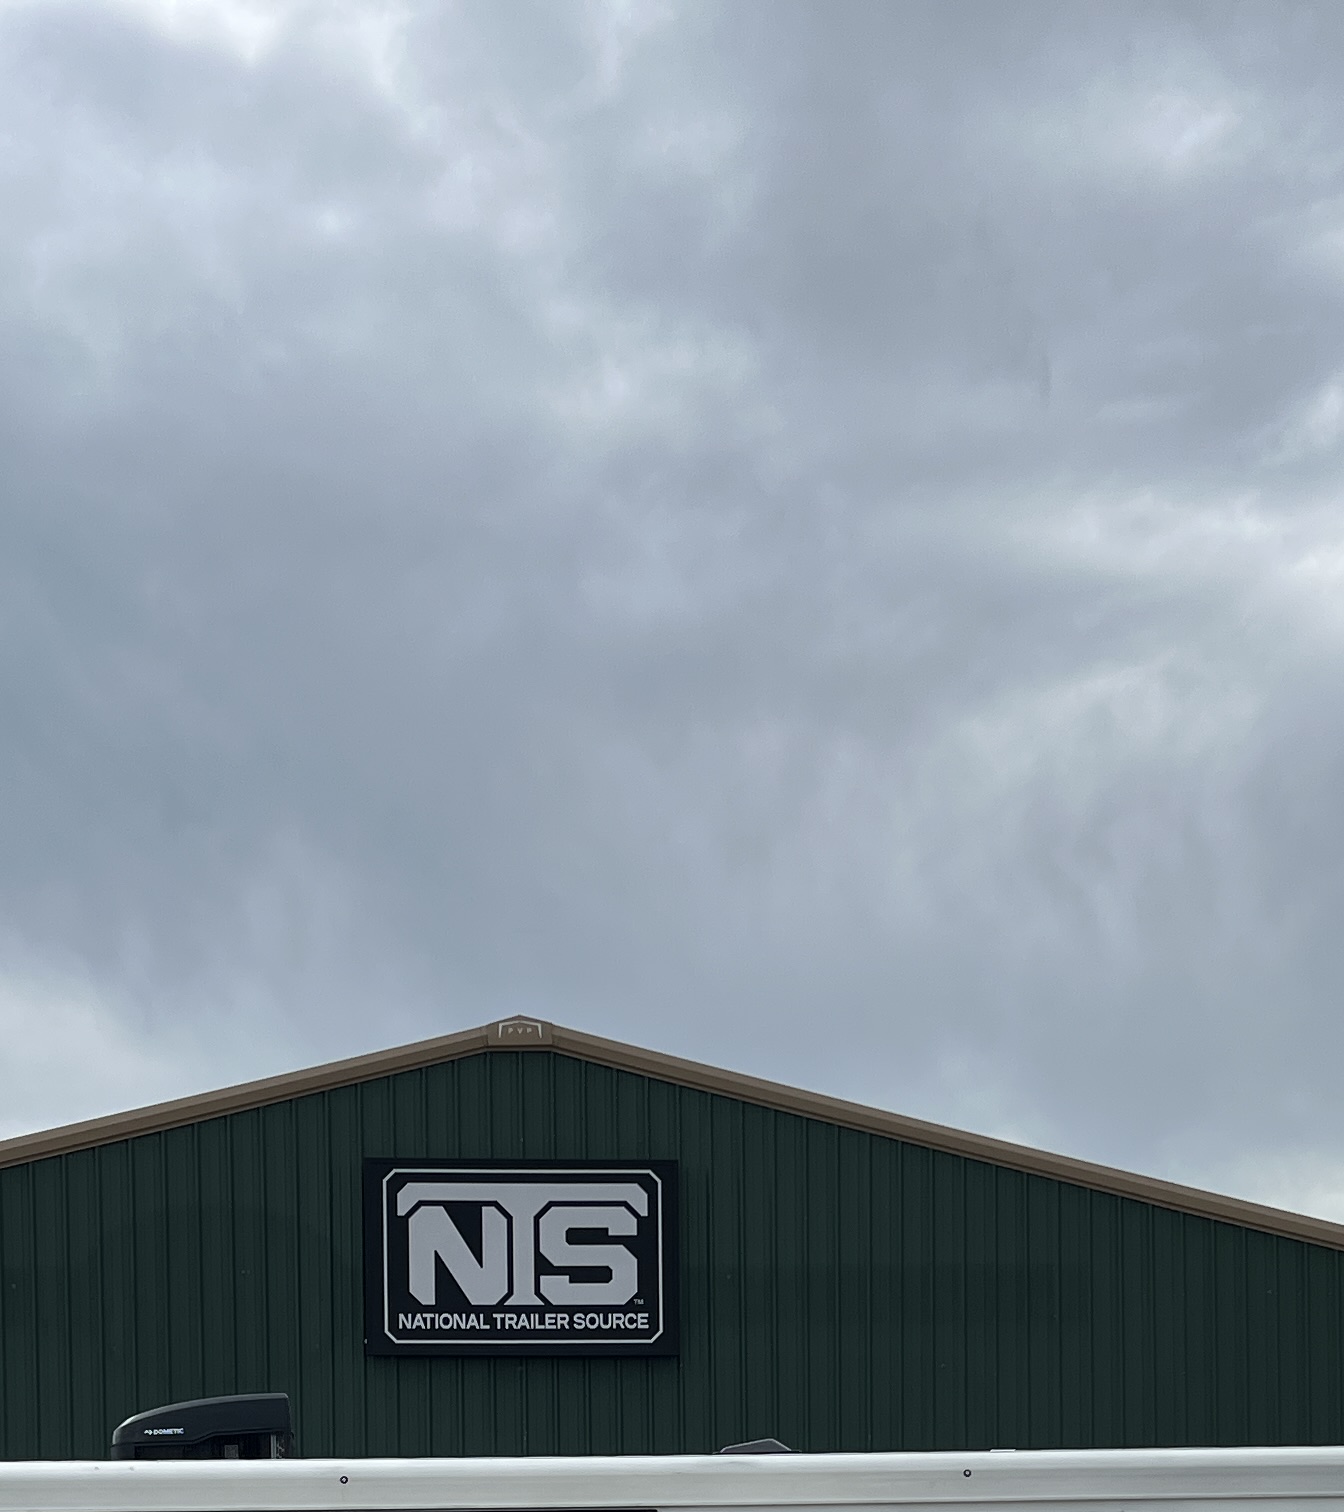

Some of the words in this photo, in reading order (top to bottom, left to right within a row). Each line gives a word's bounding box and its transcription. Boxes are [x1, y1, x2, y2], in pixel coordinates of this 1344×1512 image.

[397, 1182, 649, 1306] NTS
[398, 1312, 490, 1330] NATIONAL
[492, 1312, 570, 1330] TRAILER
[573, 1312, 649, 1330] SOURCE
